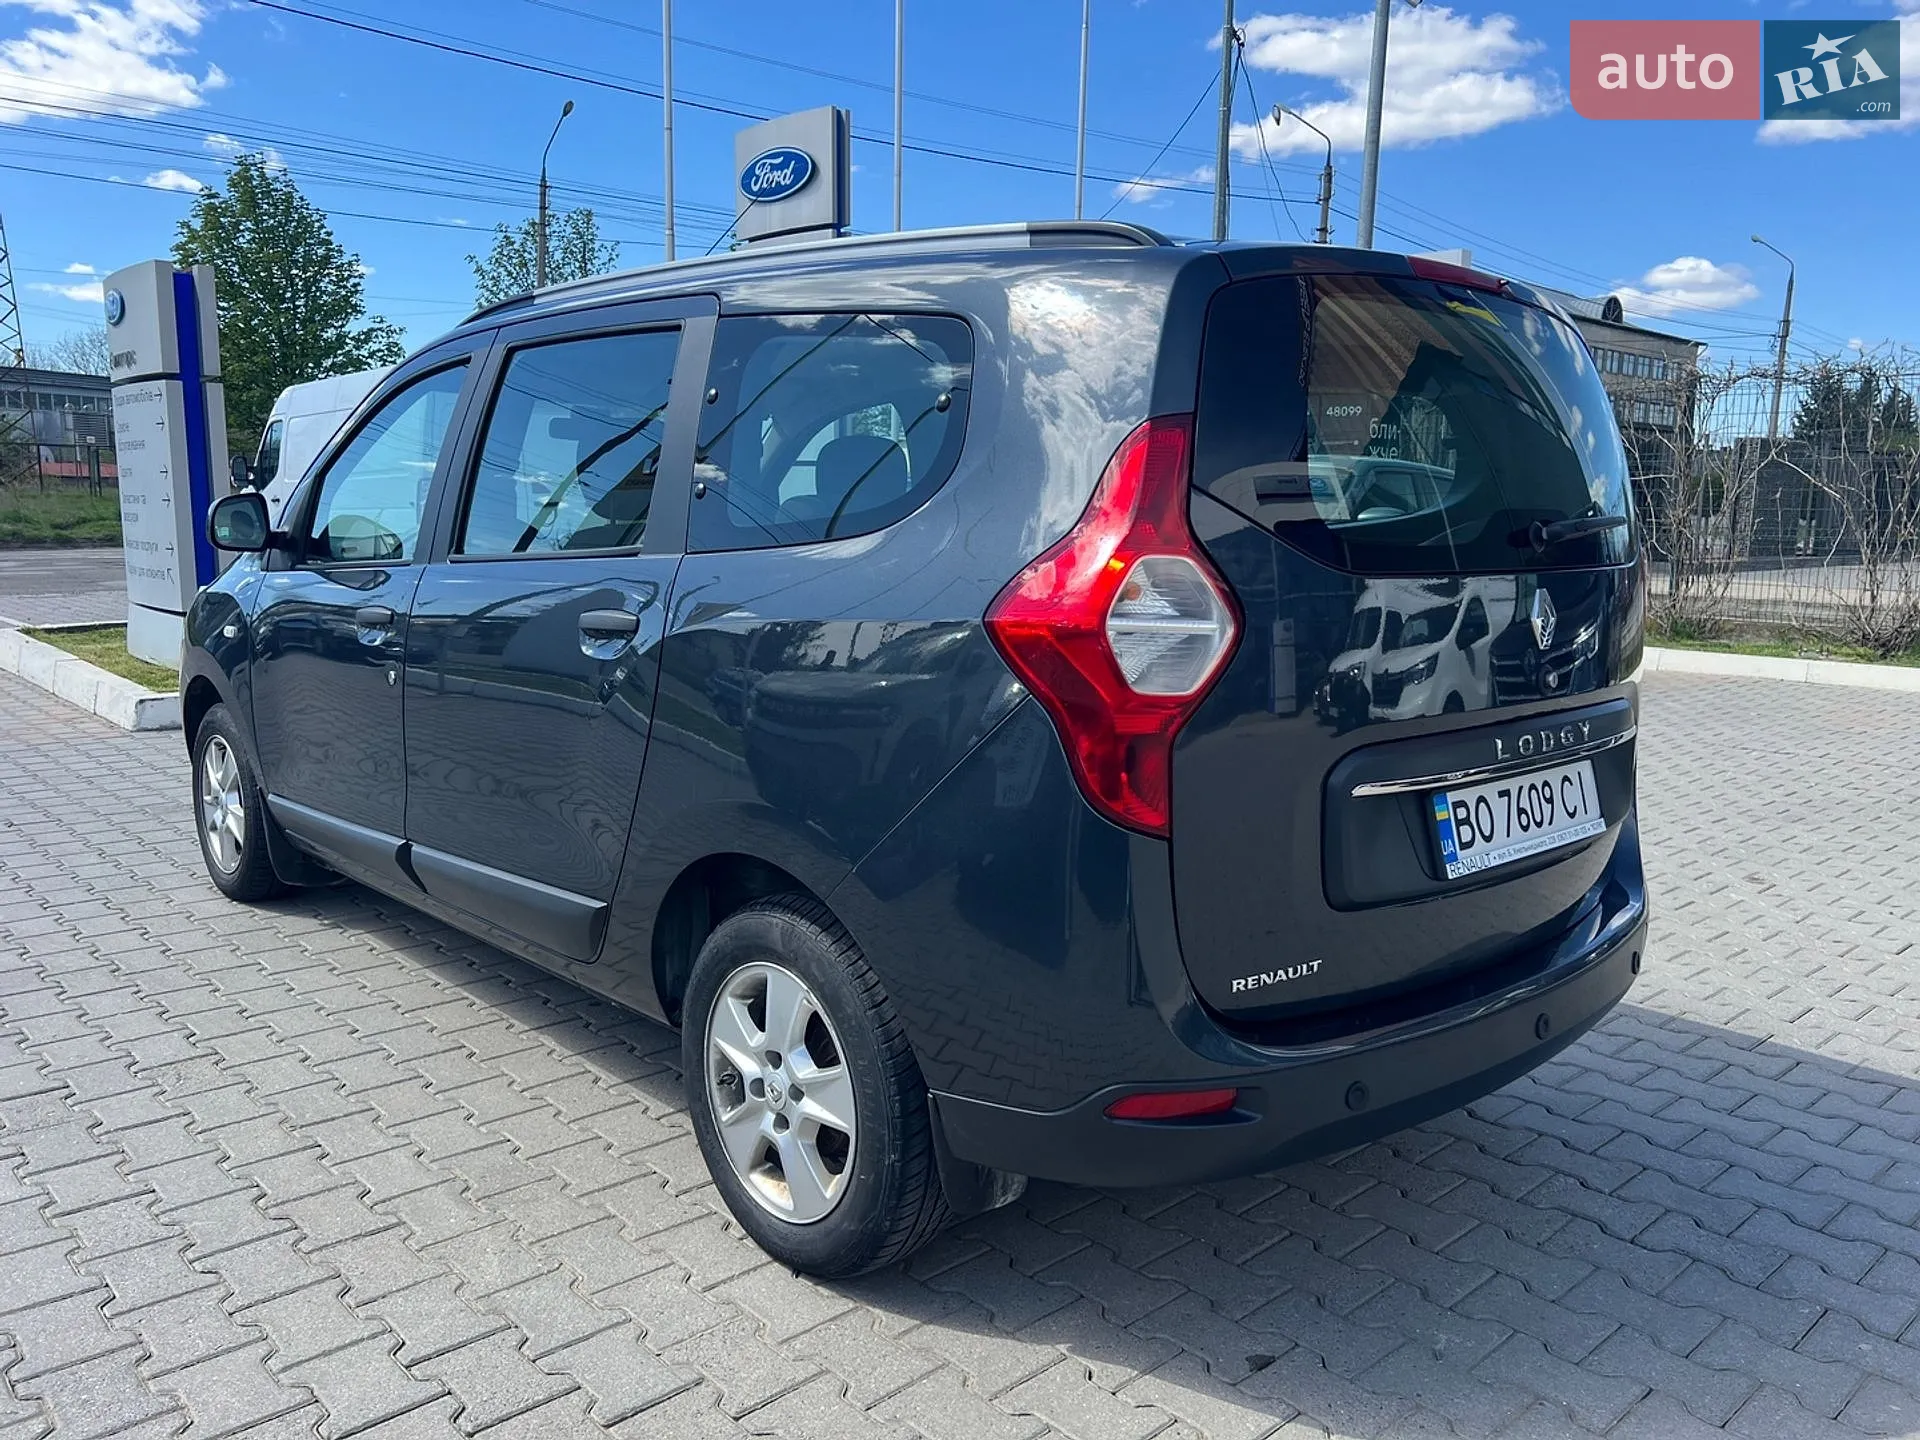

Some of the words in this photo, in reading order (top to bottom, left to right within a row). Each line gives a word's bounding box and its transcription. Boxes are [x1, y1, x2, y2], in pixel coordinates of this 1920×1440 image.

[750, 156, 796, 192] Ford
[1326, 405, 1363, 417] 48099
[1494, 720, 1592, 760] LODGY
[1498, 780, 1555, 838] 7609
[1441, 838, 1455, 855] UA
[1449, 852, 1492, 876] RENAULT
[1231, 959, 1323, 993] RENAULT
